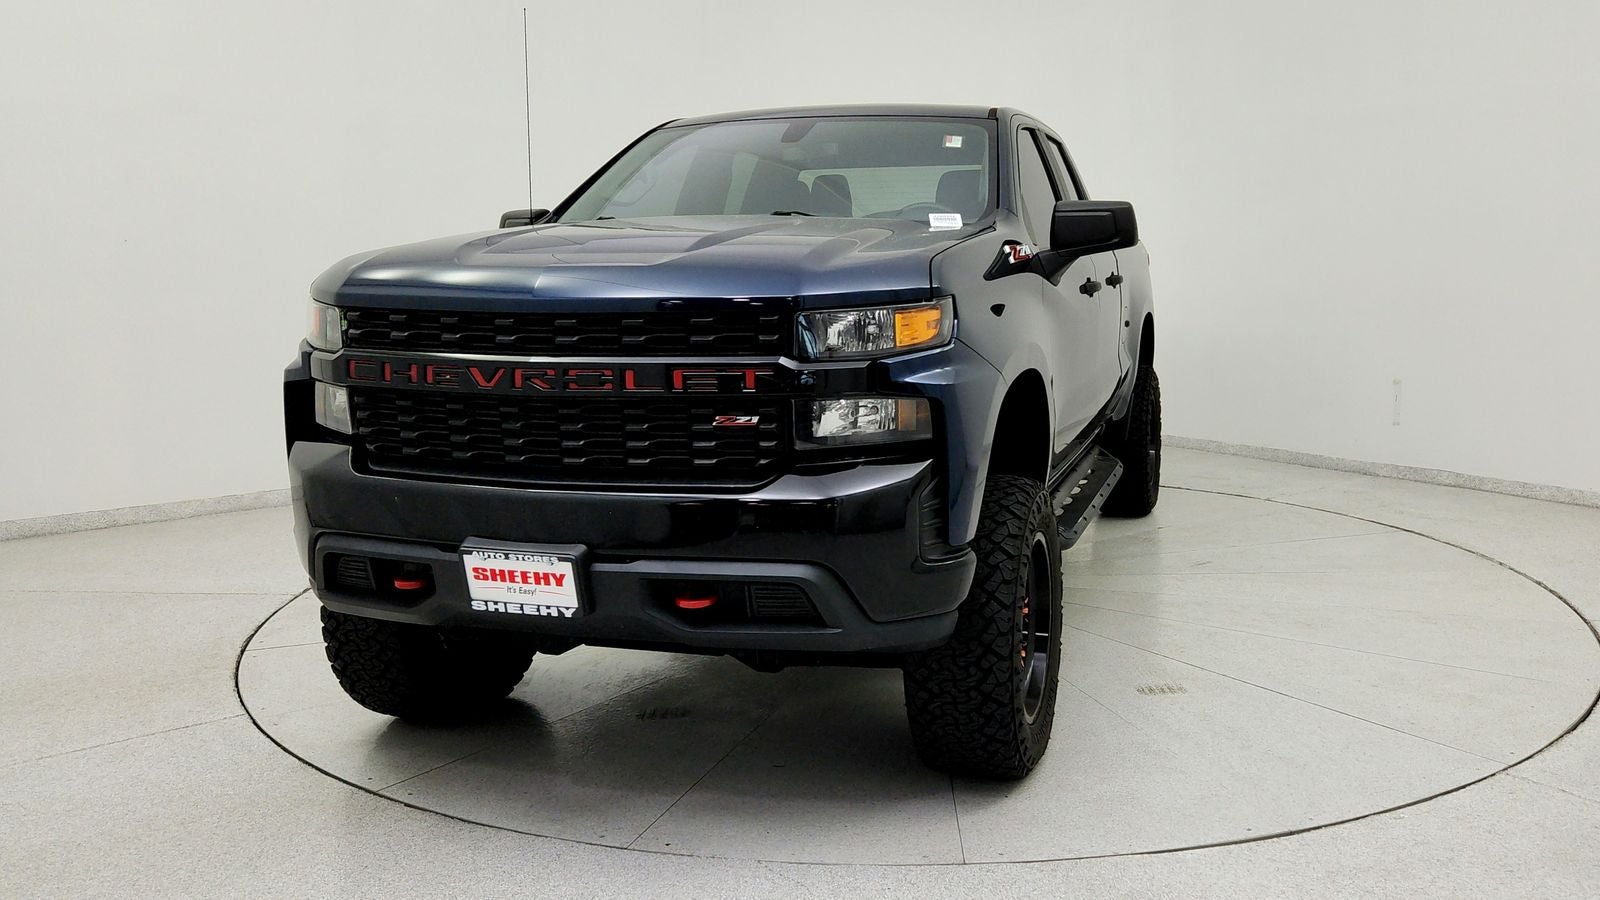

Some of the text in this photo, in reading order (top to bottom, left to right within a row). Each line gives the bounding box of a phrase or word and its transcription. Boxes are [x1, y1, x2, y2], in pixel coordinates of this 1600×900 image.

[1003, 244, 1032, 264] Z71
[348, 359, 775, 392] CHEVROLET
[712, 415, 760, 426] Z71
[471, 551, 559, 564] AUTO STORES
[472, 567, 566, 587] SHEEHY
[506, 586, 537, 597] It's Easy!
[471, 600, 577, 618] SHEEHY
